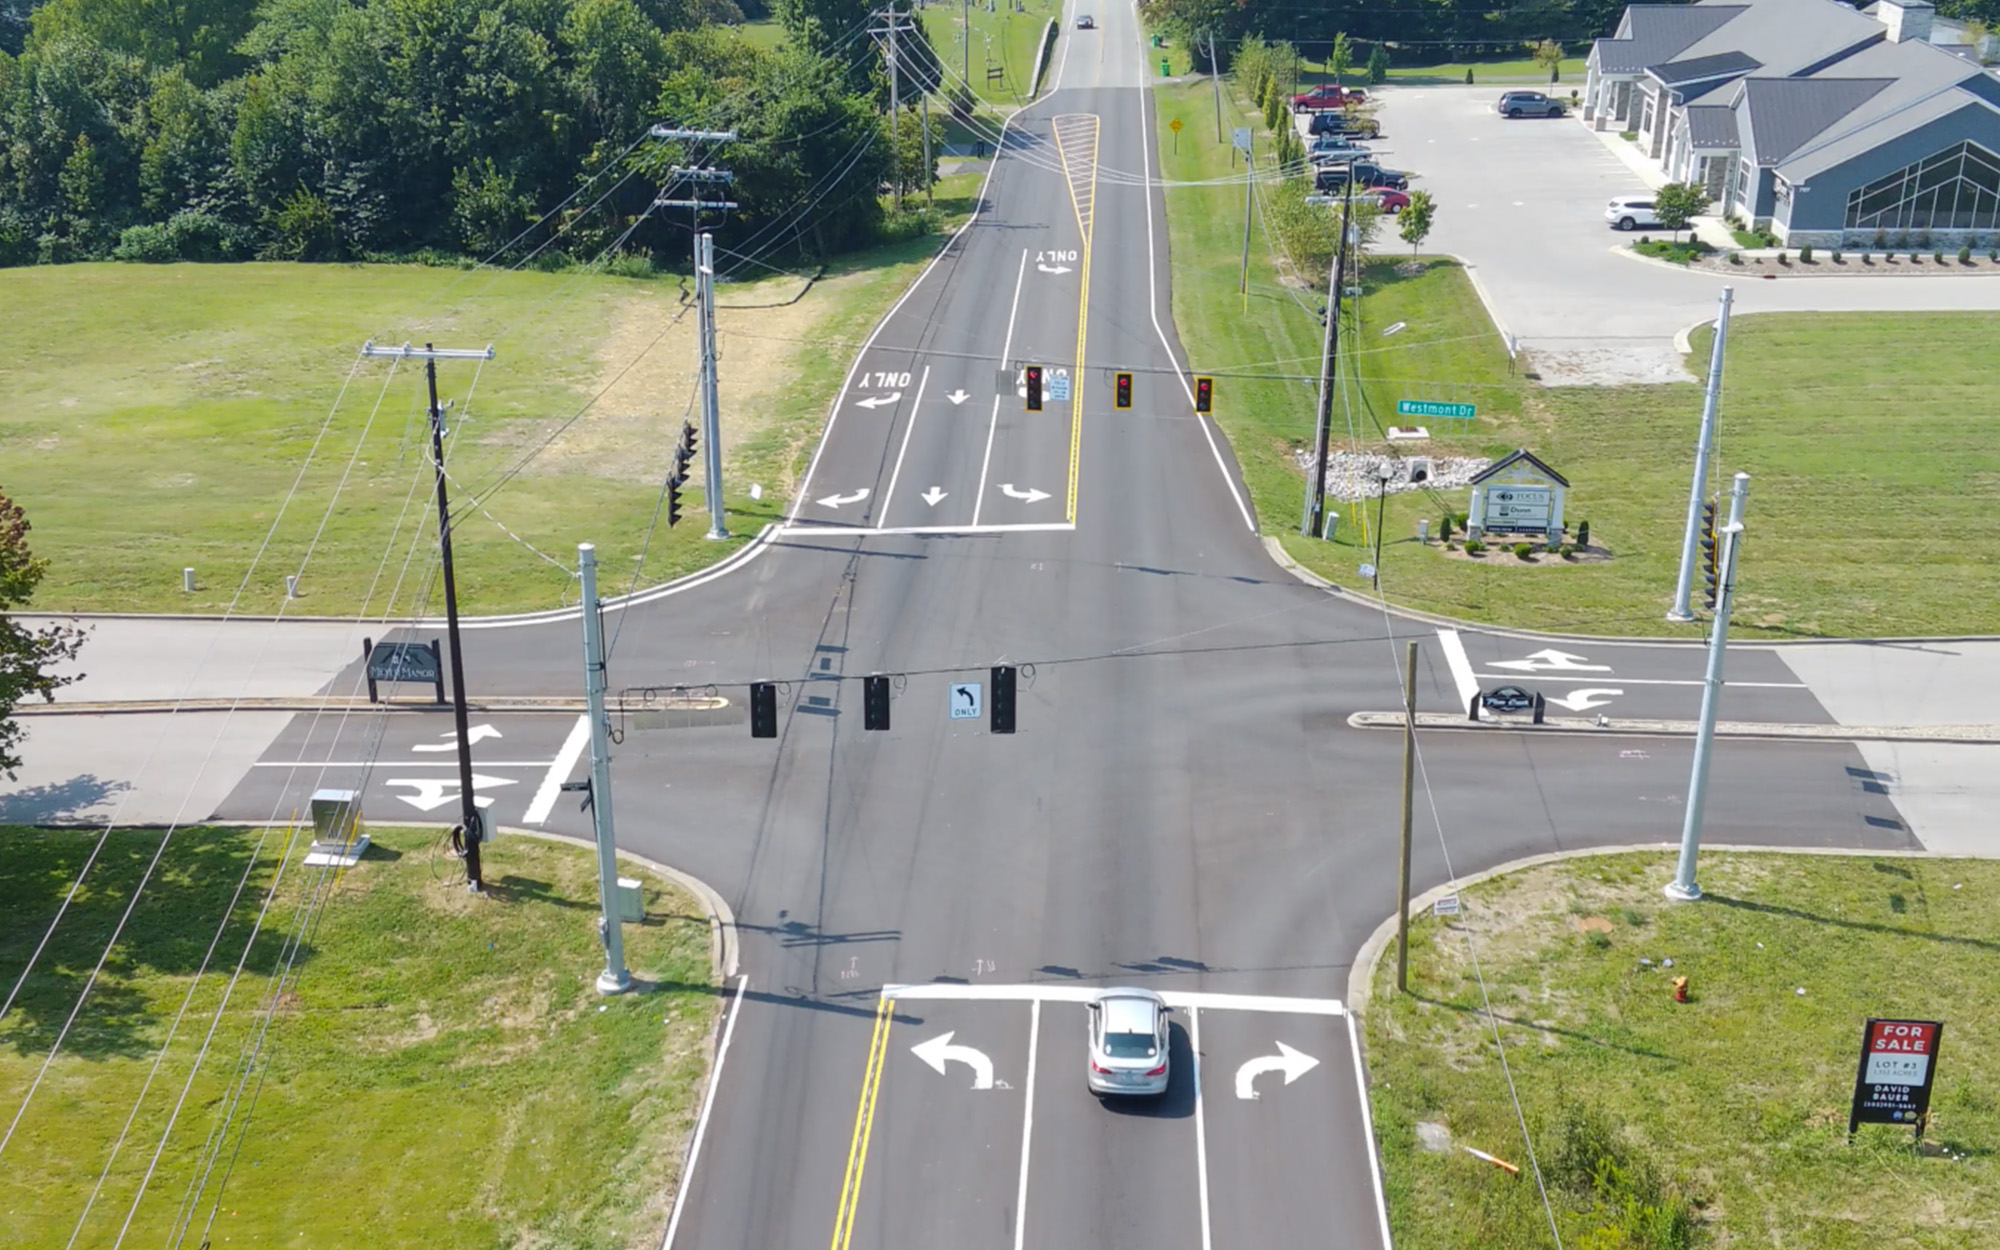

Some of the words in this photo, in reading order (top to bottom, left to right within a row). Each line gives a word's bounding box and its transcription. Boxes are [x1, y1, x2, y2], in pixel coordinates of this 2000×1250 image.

[1035, 250, 1078, 262] ONLY
[858, 372, 911, 388] ONLY
[1402, 402, 1457, 416] Westmont
[1459, 405, 1473, 417] Dr
[954, 708, 977, 716] ONLY
[1883, 1025, 1923, 1037] FOR
[1875, 1039, 1926, 1051] SALE
[1876, 1061, 1898, 1069] LOT
[1874, 1085, 1910, 1093] DAVID
[1872, 1093, 1910, 1102] BAUER
